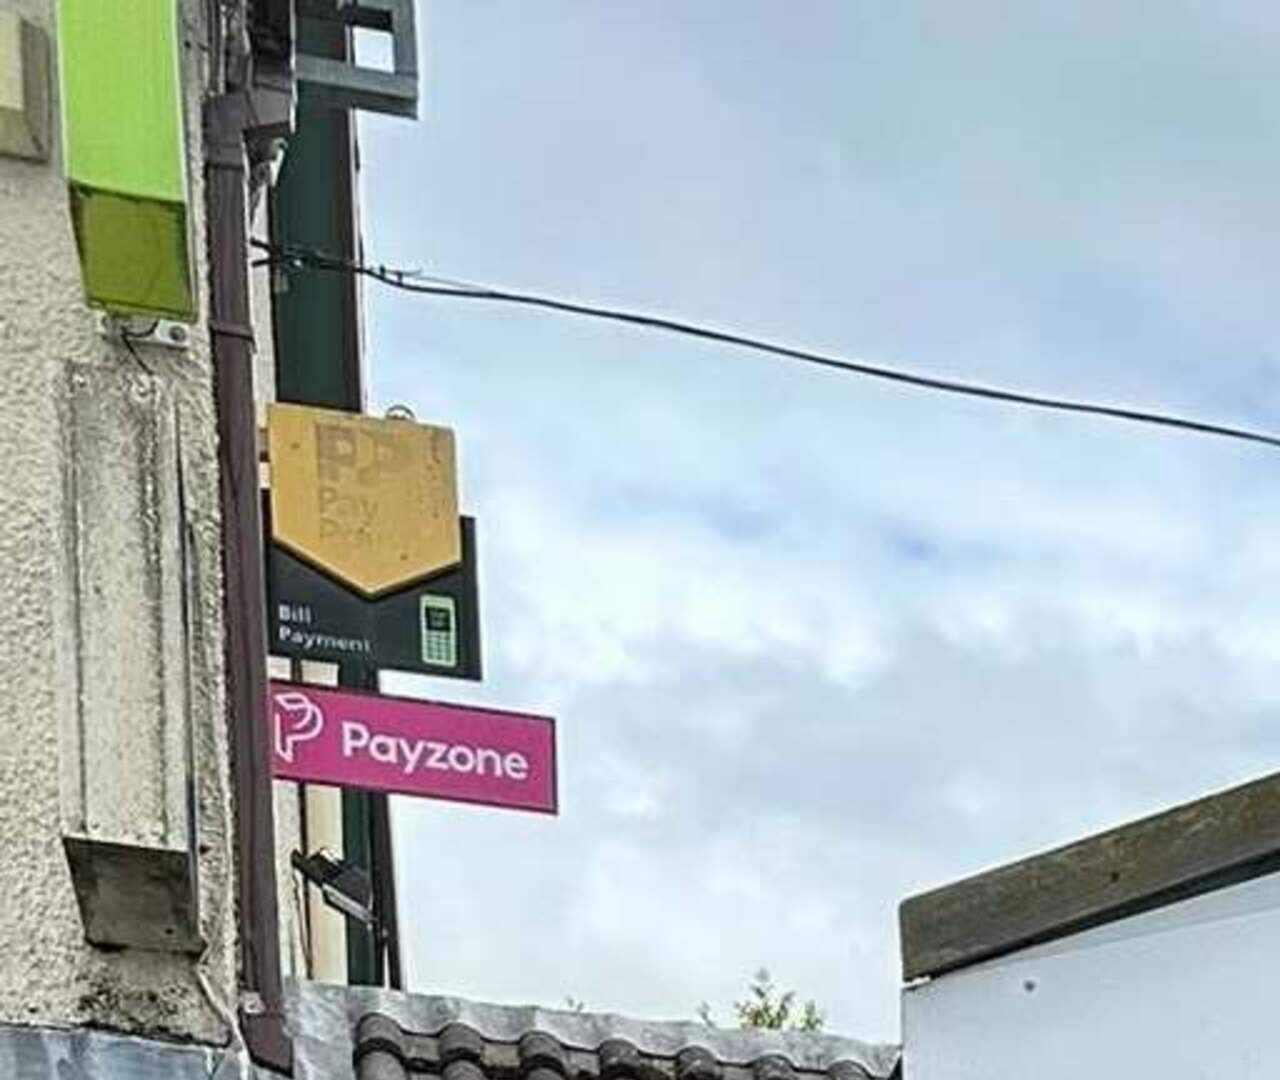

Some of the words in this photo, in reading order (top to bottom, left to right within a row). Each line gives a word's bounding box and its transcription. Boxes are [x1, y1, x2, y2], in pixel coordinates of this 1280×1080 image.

[278, 604, 312, 624] Bill
[278, 625, 371, 653] Payment
[342, 722, 529, 780] Payzone
